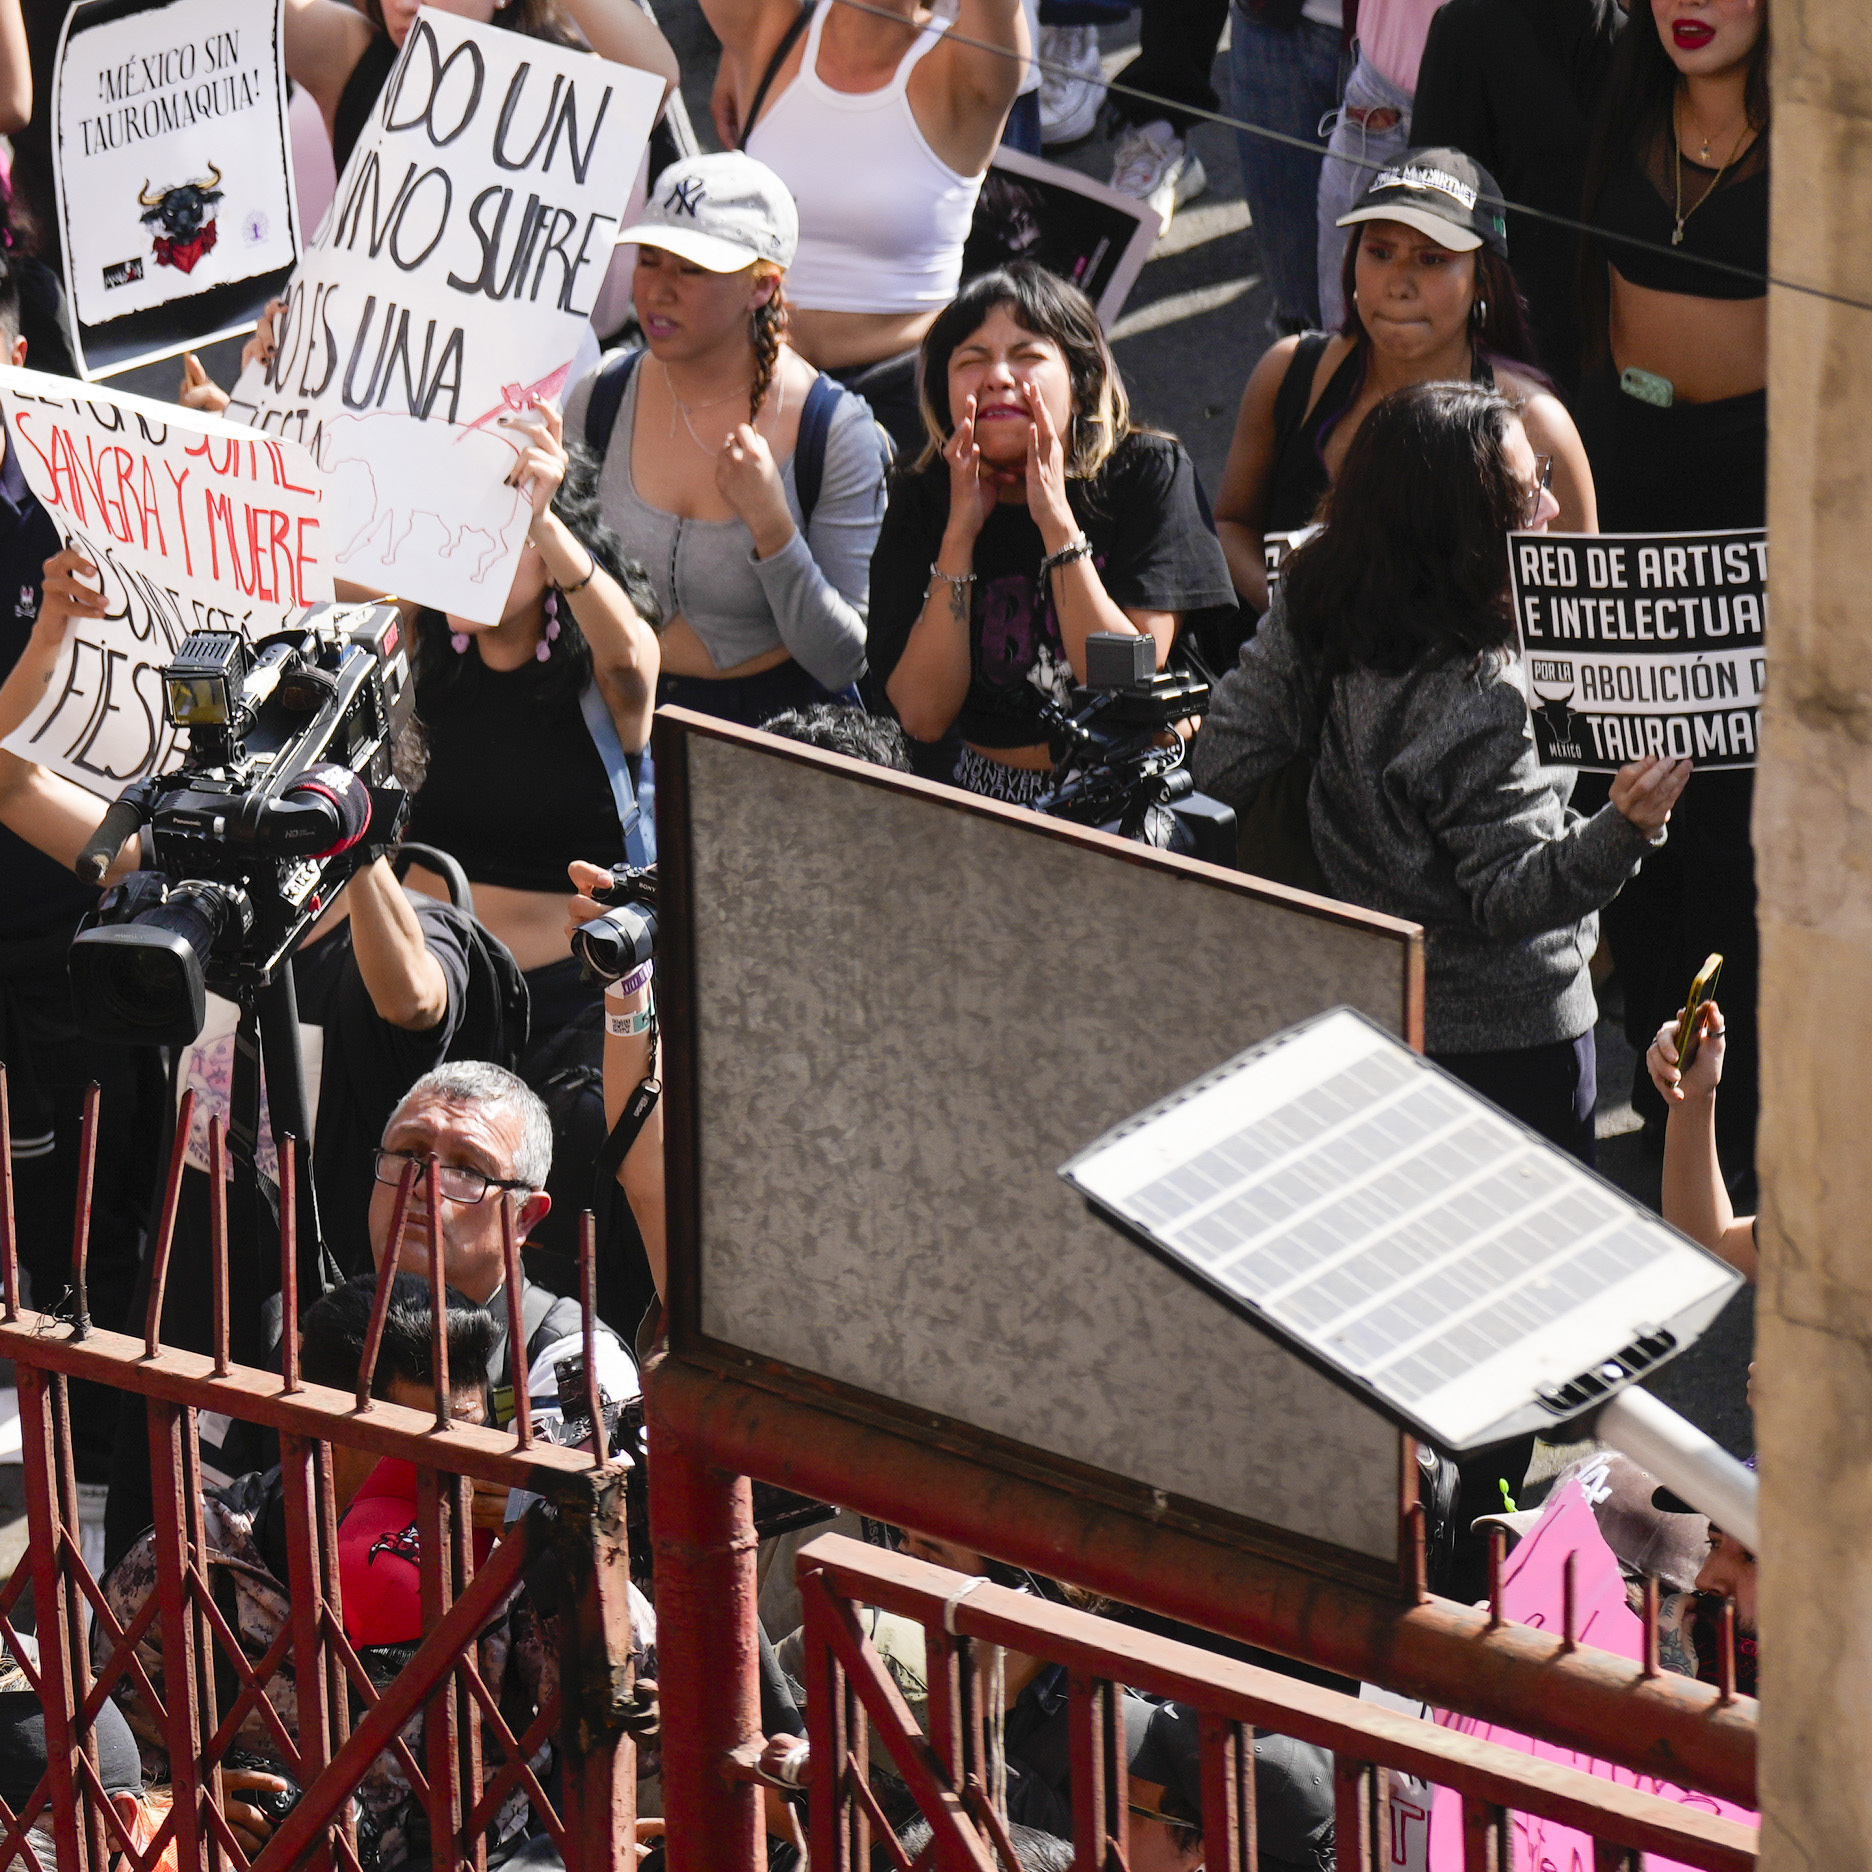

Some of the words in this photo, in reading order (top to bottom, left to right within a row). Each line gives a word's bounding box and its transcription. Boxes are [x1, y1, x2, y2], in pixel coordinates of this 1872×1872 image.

[204, 29, 240, 74] SIN
[79, 69, 260, 157] TAUROMAQUIA!
[492, 62, 613, 185] UN
[446, 186, 617, 318] SUFRE
[341, 295, 464, 425] UNA
[16, 412, 167, 557] SANGRA
[164, 459, 194, 576] Y
[205, 487, 321, 608] MUERE
[1519, 545, 1578, 588] RED
[1586, 547, 1628, 589] DE
[1638, 541, 1768, 589] ARTIST
[1524, 596, 1544, 638] E
[1550, 593, 1768, 641] INTELECTUA
[1535, 662, 1555, 681] POR
[1557, 663, 1572, 681] LA
[1580, 655, 1739, 703] ABOLICIÓN
[1586, 710, 1762, 762] TAUROMA
